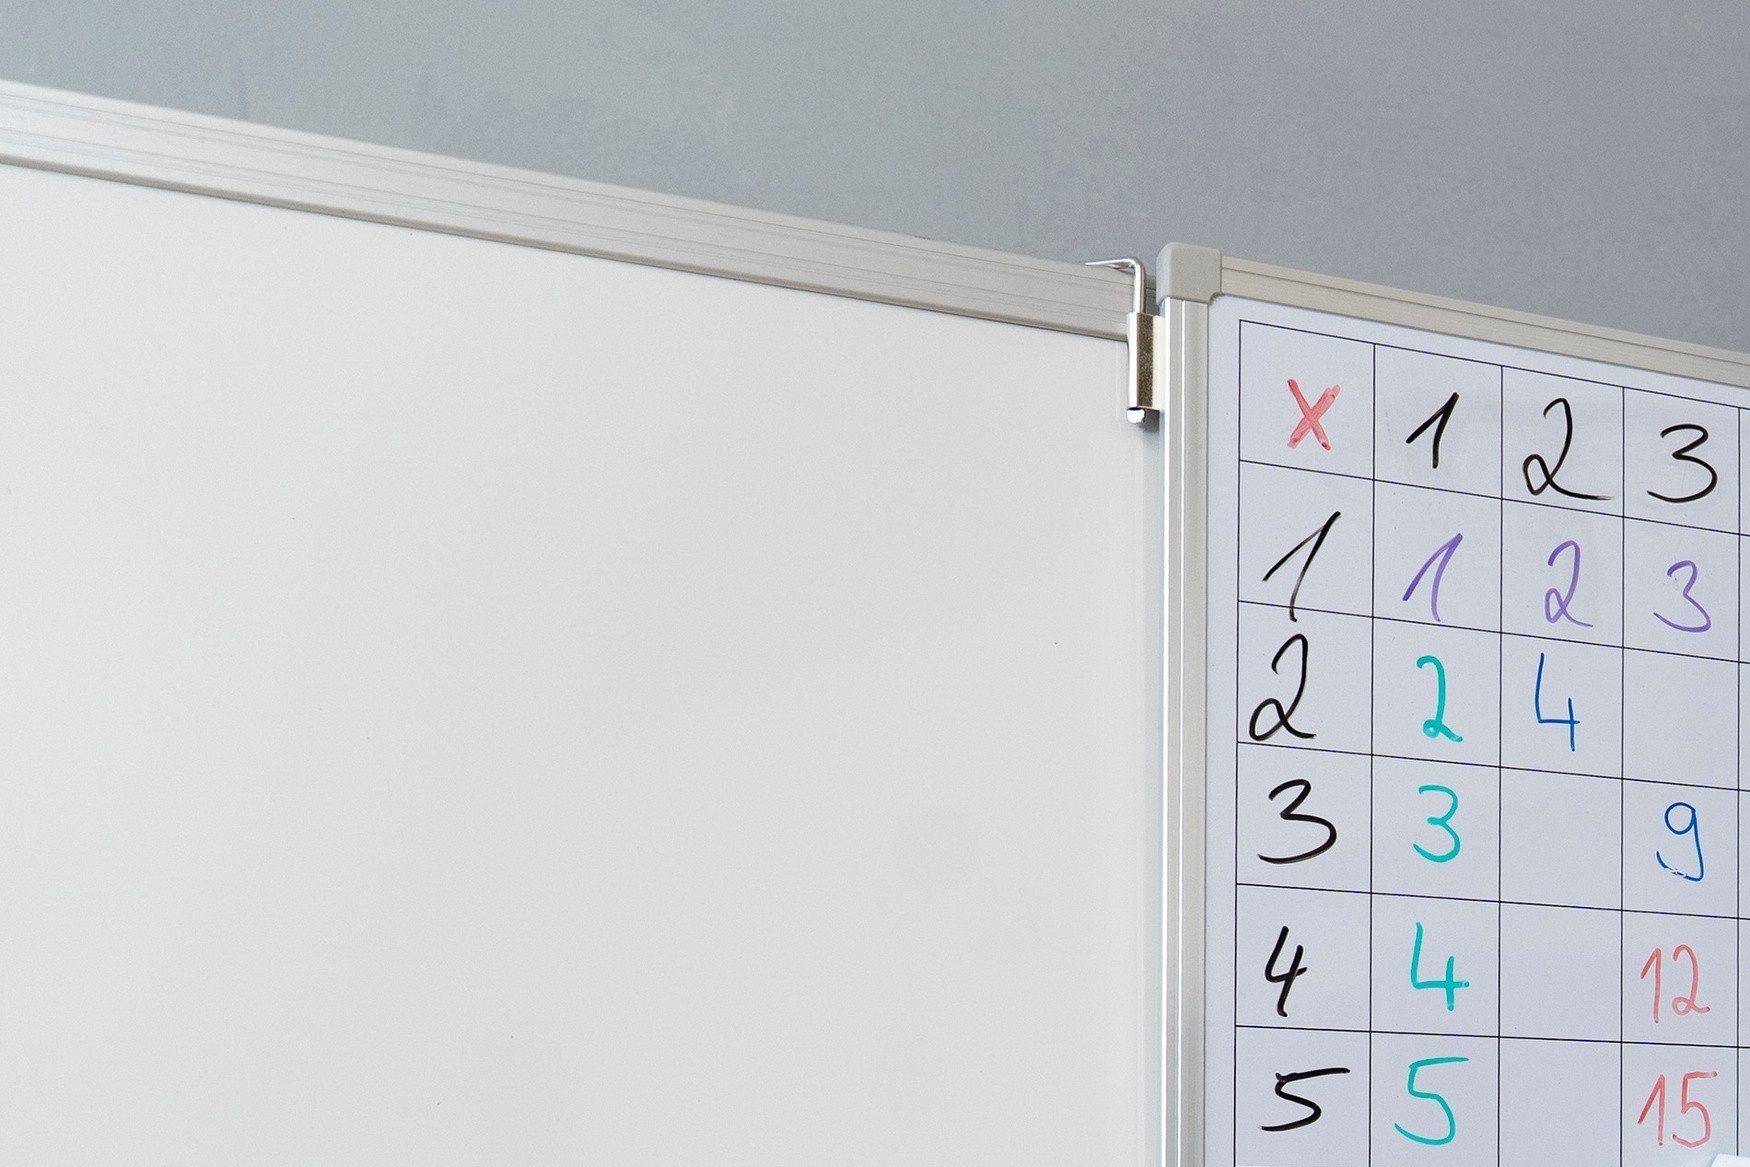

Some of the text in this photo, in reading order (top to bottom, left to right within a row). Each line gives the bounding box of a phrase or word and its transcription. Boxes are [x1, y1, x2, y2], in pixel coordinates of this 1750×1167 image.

[1405, 392, 1458, 468] 1
[1522, 398, 1614, 501] 2
[1647, 424, 1718, 502] 3
[1262, 511, 1341, 622] 1
[1402, 533, 1463, 623] 1
[1544, 539, 1592, 628] 2
[1654, 560, 1711, 632] 3
[1248, 634, 1579, 752] 2 2 4
[1258, 778, 1703, 881] 3 3 9
[1264, 926, 1307, 1017] 4
[1410, 921, 1470, 1011] 4
[1640, 944, 1710, 1024] 12
[1260, 1067, 1350, 1131] 5
[1394, 1056, 1469, 1145] 5
[1638, 1071, 1718, 1148] 15
